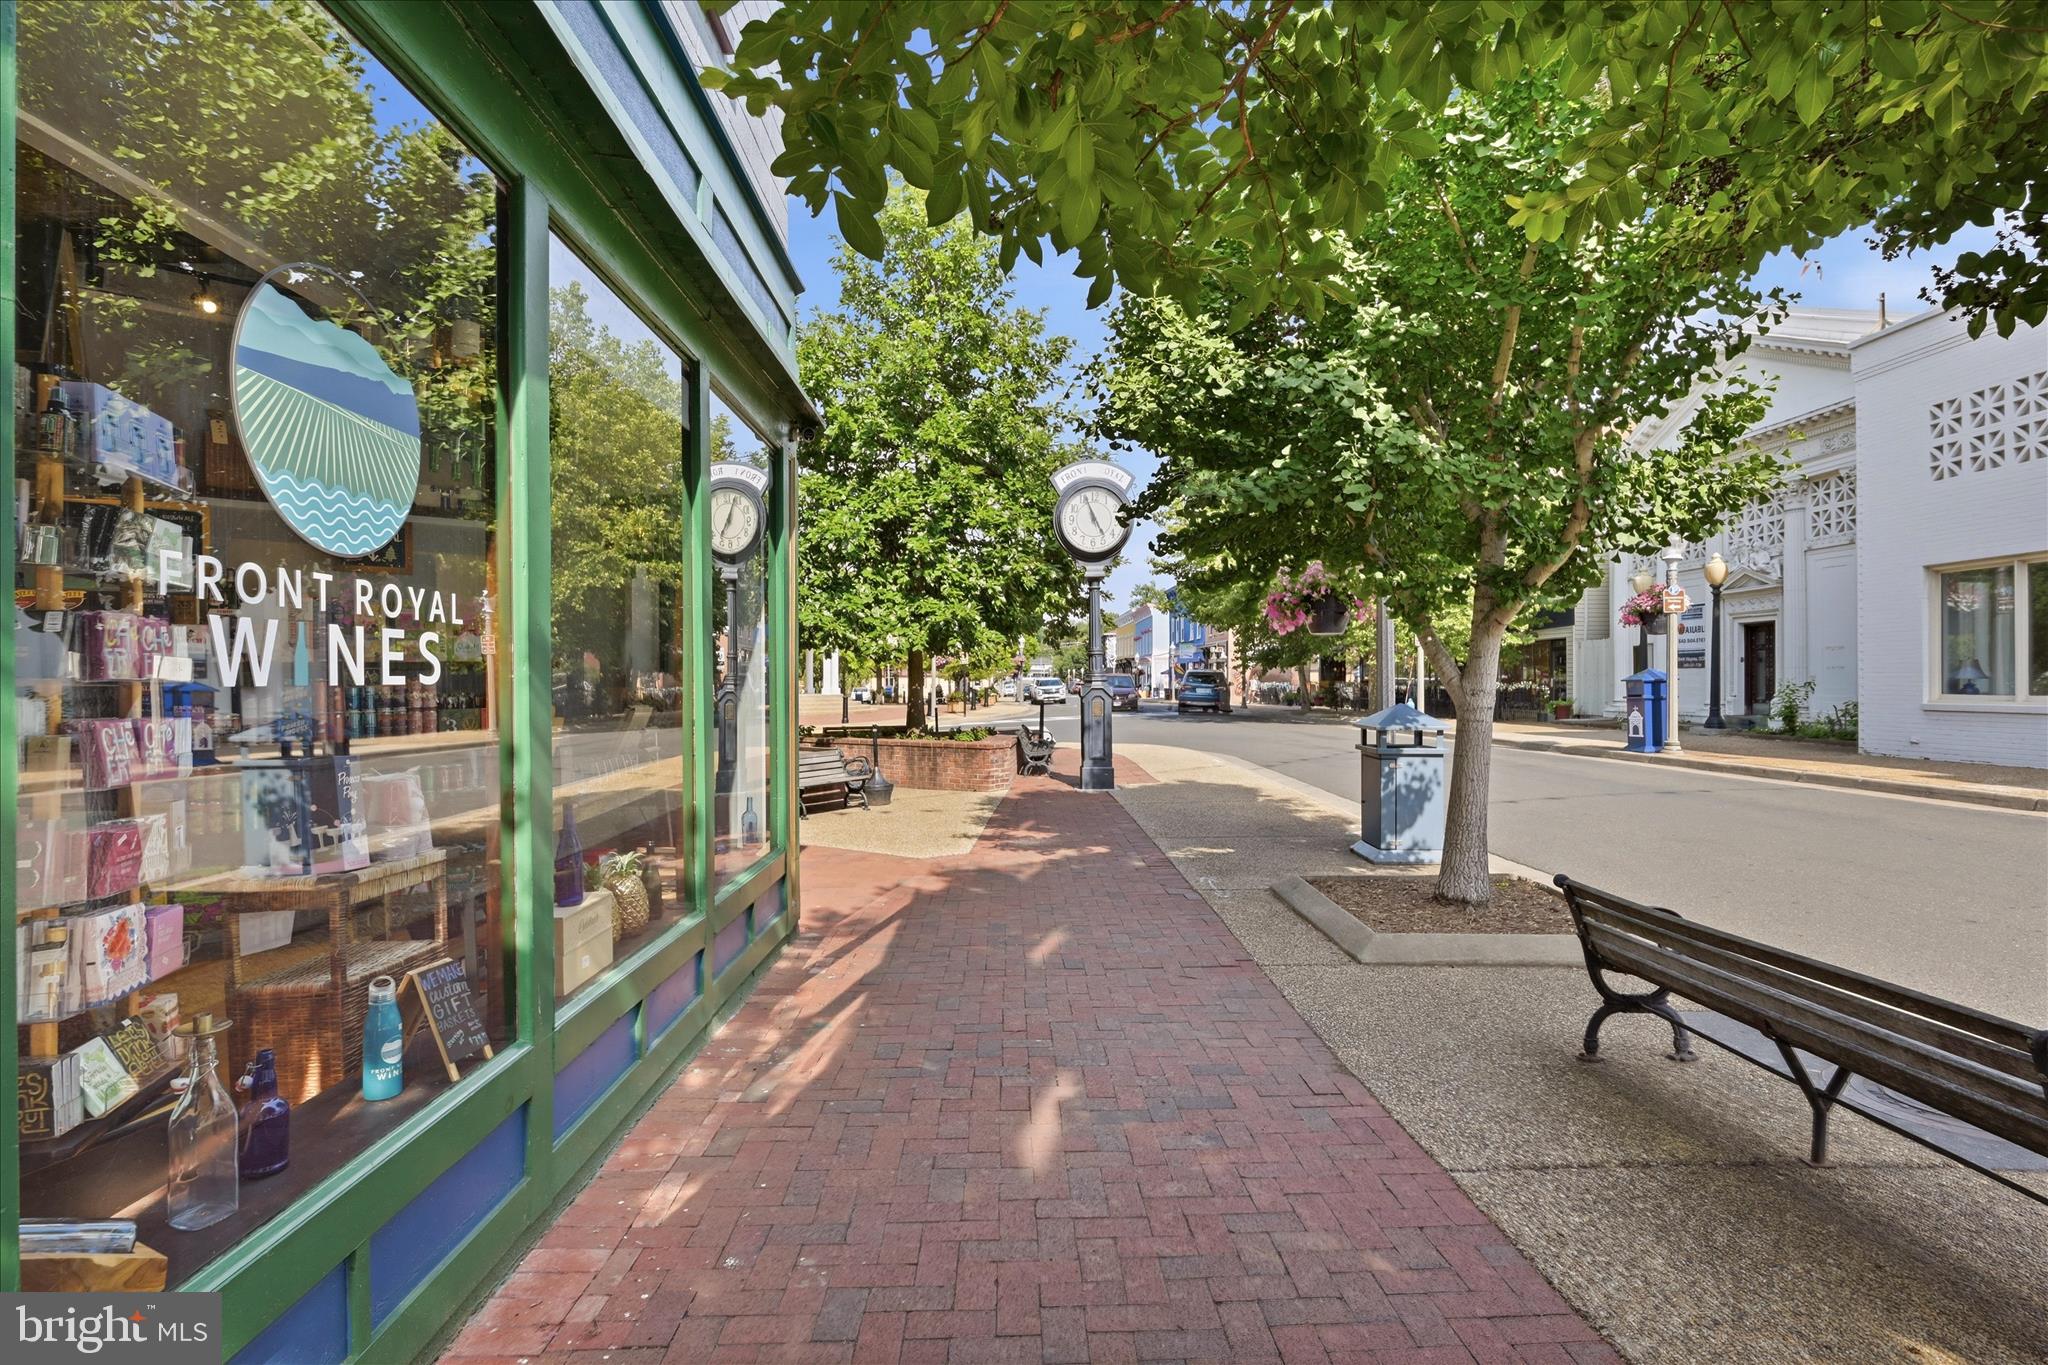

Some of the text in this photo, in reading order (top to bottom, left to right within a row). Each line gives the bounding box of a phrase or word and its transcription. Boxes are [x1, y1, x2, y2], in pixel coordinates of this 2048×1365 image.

[159, 550, 464, 625] FRONT ROYAL
[208, 614, 442, 688] WINES
[420, 961, 465, 992] WE MAKE
[429, 981, 471, 1005] custom
[433, 991, 472, 1020] GIFT
[437, 1007, 476, 1033] BASKETS
[376, 1067, 402, 1081] WIN
